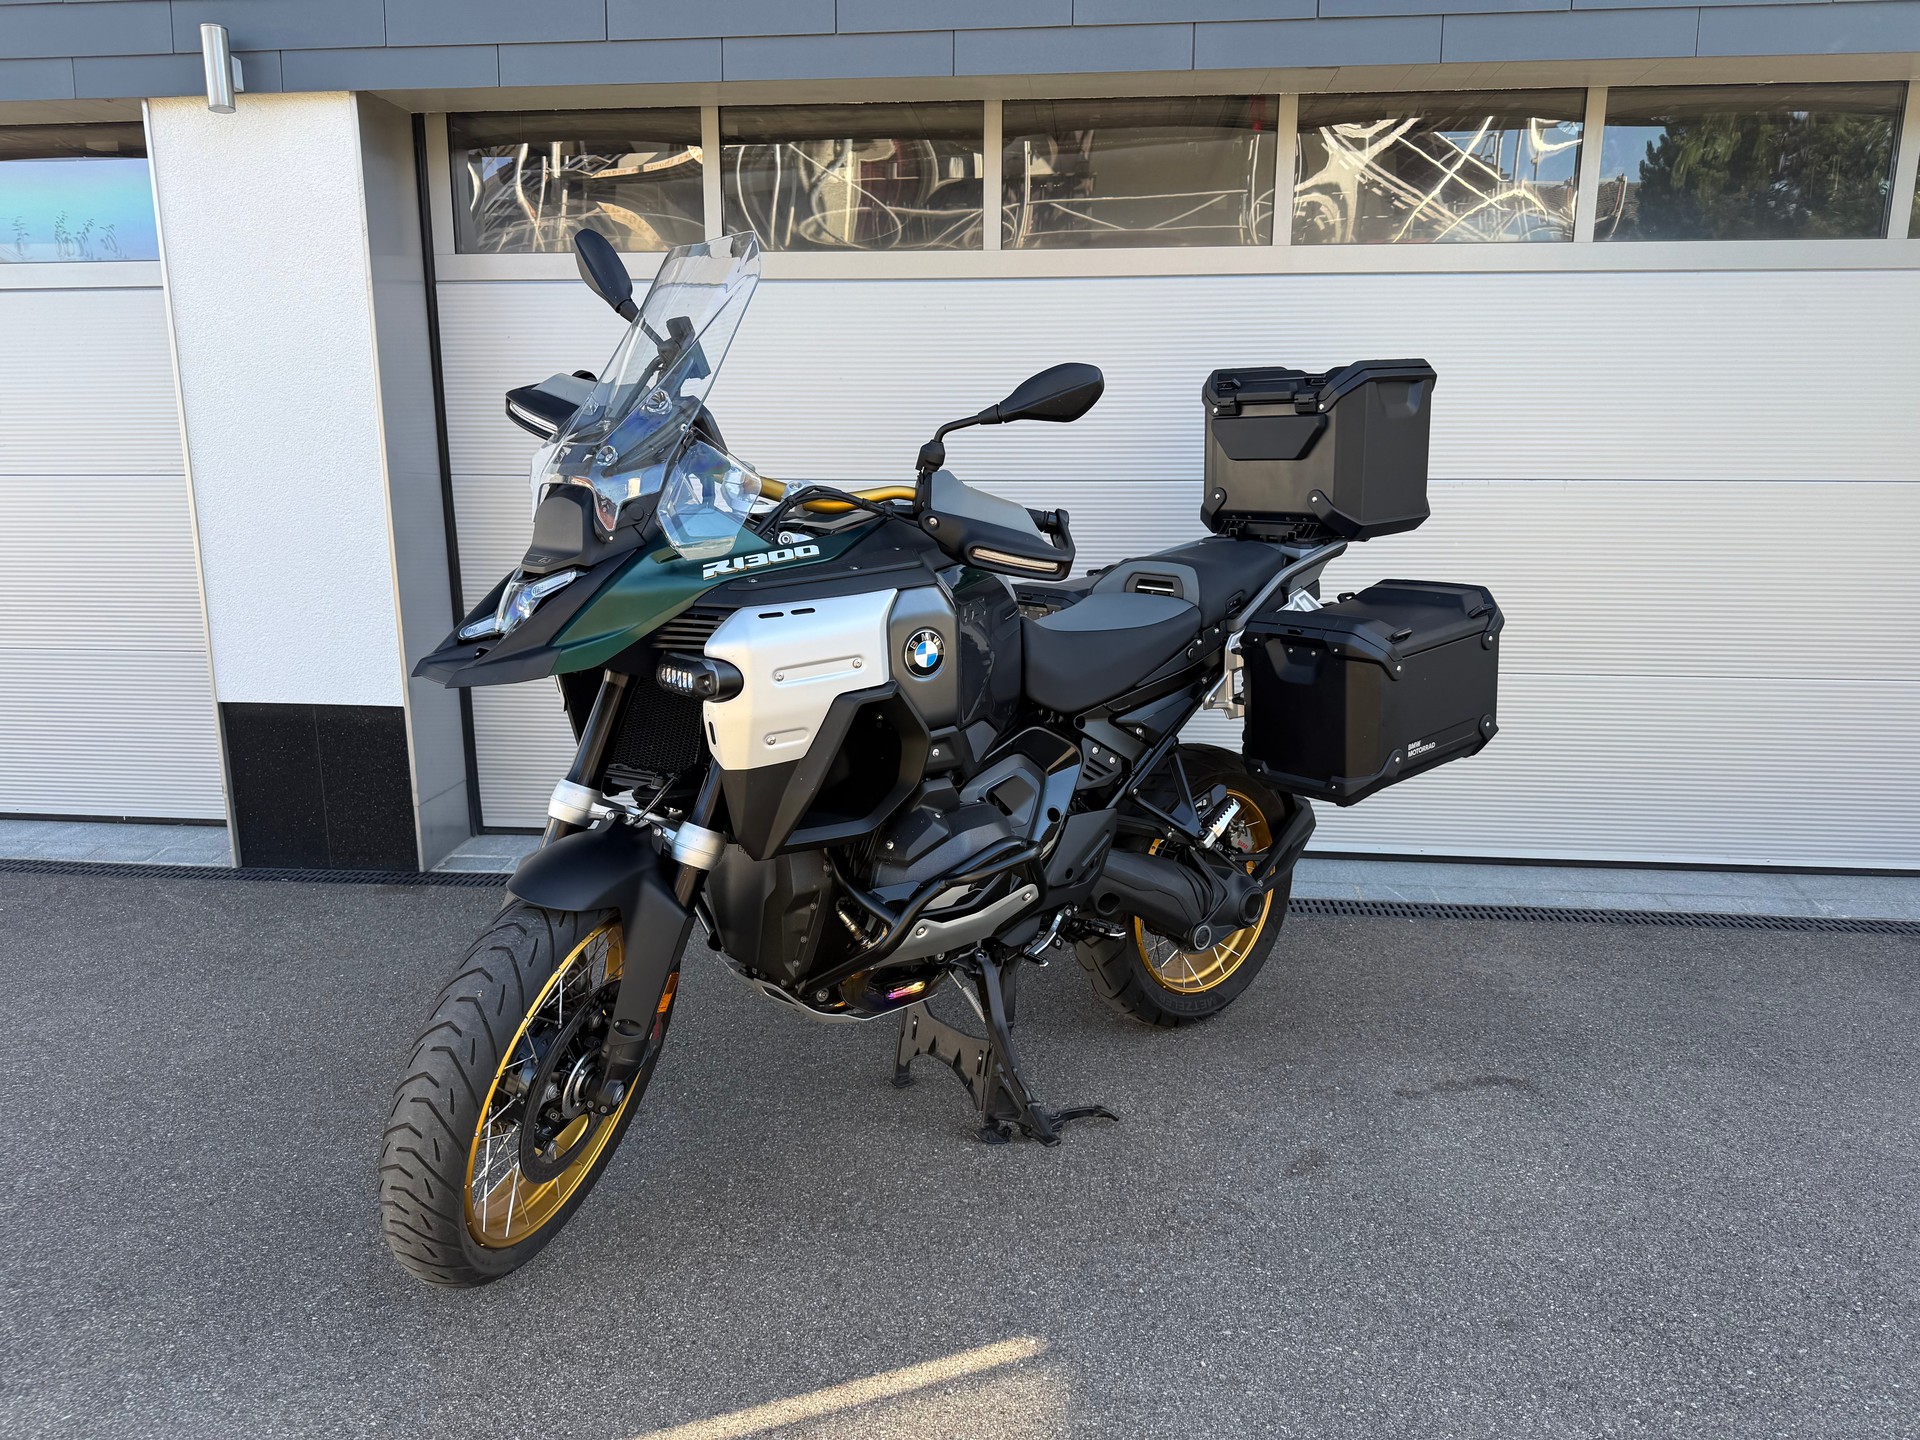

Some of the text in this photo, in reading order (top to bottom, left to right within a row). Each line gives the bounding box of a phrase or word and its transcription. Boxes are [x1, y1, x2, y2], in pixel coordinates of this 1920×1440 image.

[702, 544, 820, 581] R1300
[909, 632, 941, 650] BMW
[1407, 740, 1422, 751] BMW
[1407, 741, 1436, 758] MOTORRAD
[1159, 992, 1217, 1011] METZELER
